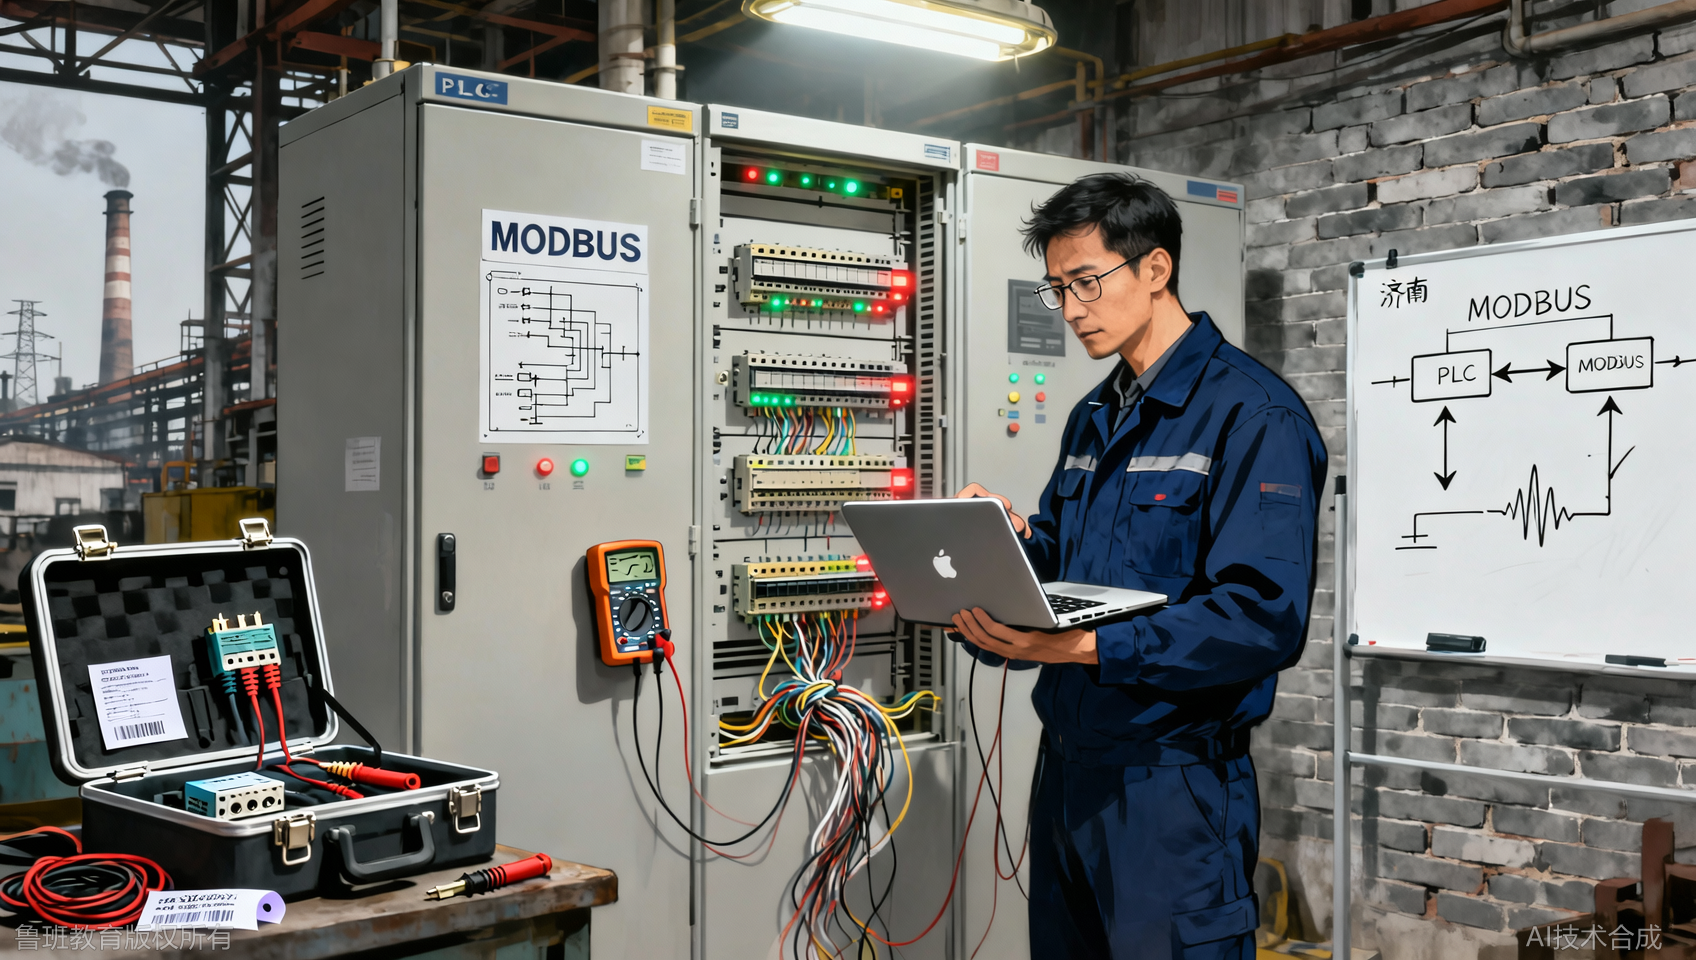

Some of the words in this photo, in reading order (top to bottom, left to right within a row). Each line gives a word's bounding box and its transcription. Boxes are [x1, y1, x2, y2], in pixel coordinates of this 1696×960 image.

[490, 220, 641, 262] MODBUS
[1380, 276, 1428, 308] 济南
[1468, 285, 1592, 321] MODBUS
[1438, 364, 1477, 385] PLC
